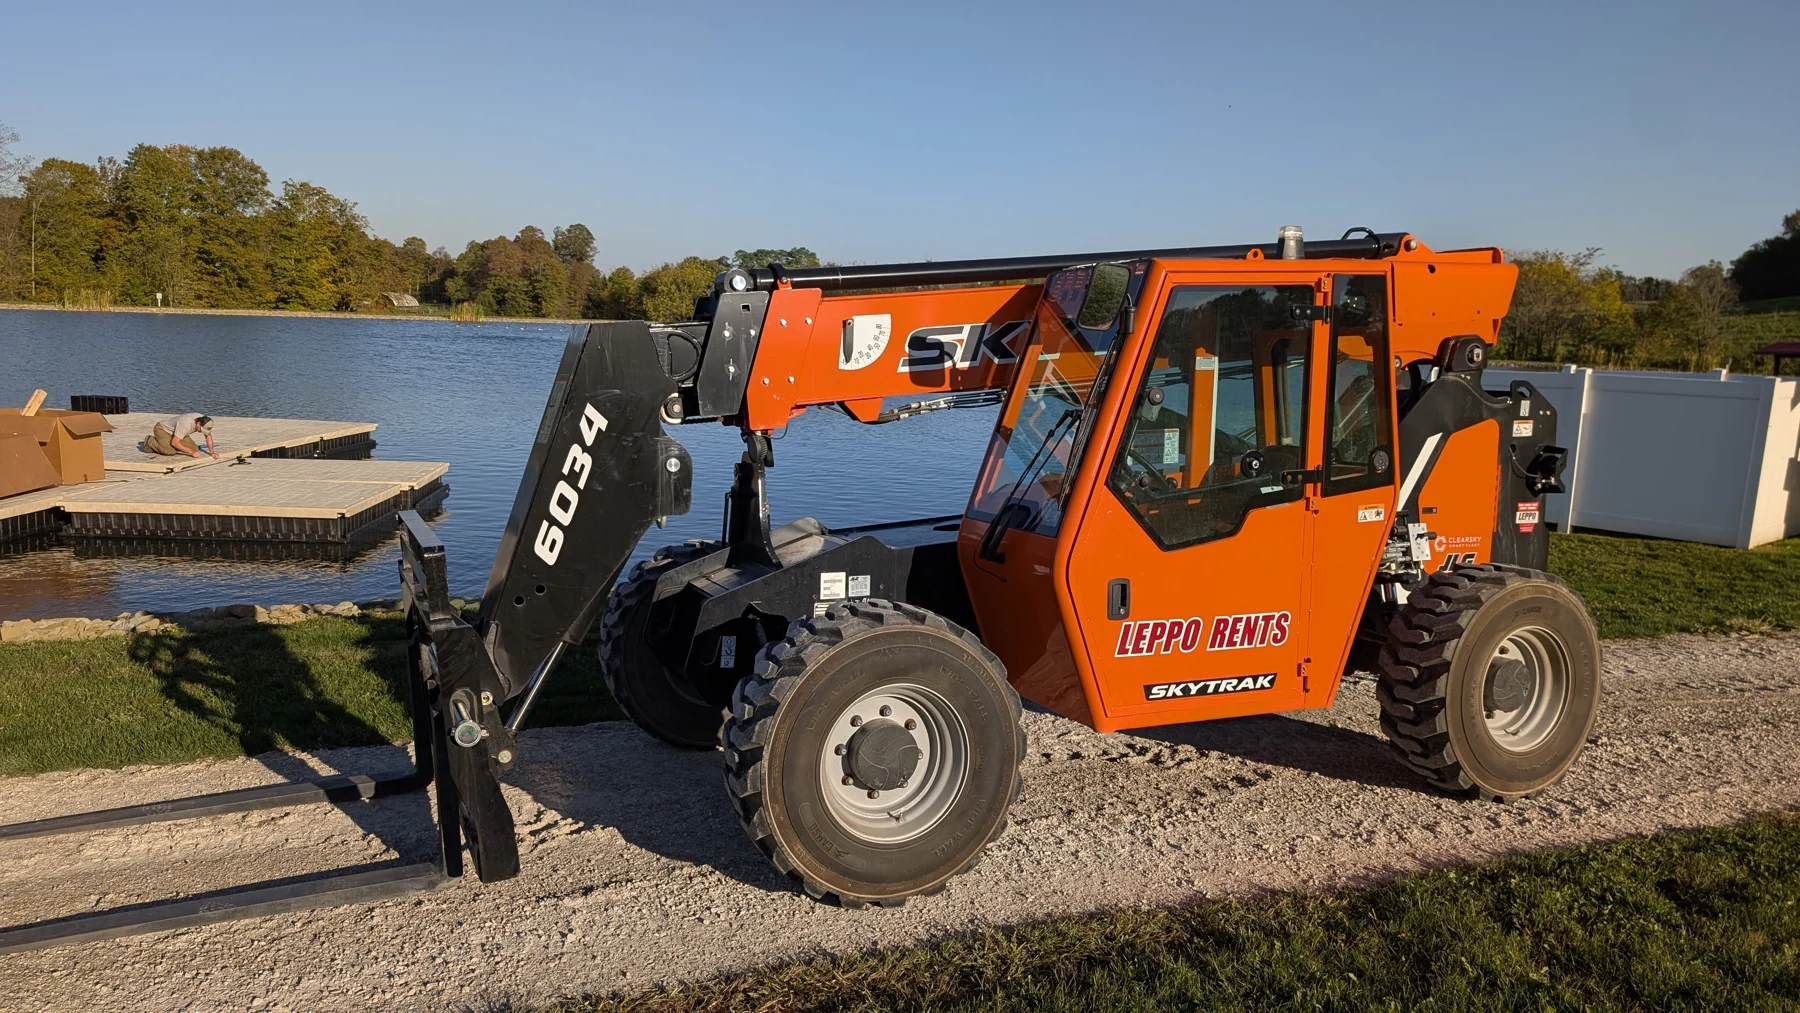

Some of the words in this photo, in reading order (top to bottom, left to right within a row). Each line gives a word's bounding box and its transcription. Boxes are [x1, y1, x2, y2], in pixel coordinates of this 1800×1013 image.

[534, 402, 608, 565] 6034
[1518, 512, 1536, 521] LEPPO
[1448, 536, 1482, 544] CLEARSKY
[1115, 617, 1203, 657] LEPPO
[1206, 611, 1291, 651] RENTS
[1148, 674, 1274, 699] SKYTRAK
[809, 822, 834, 852] CAMSO
